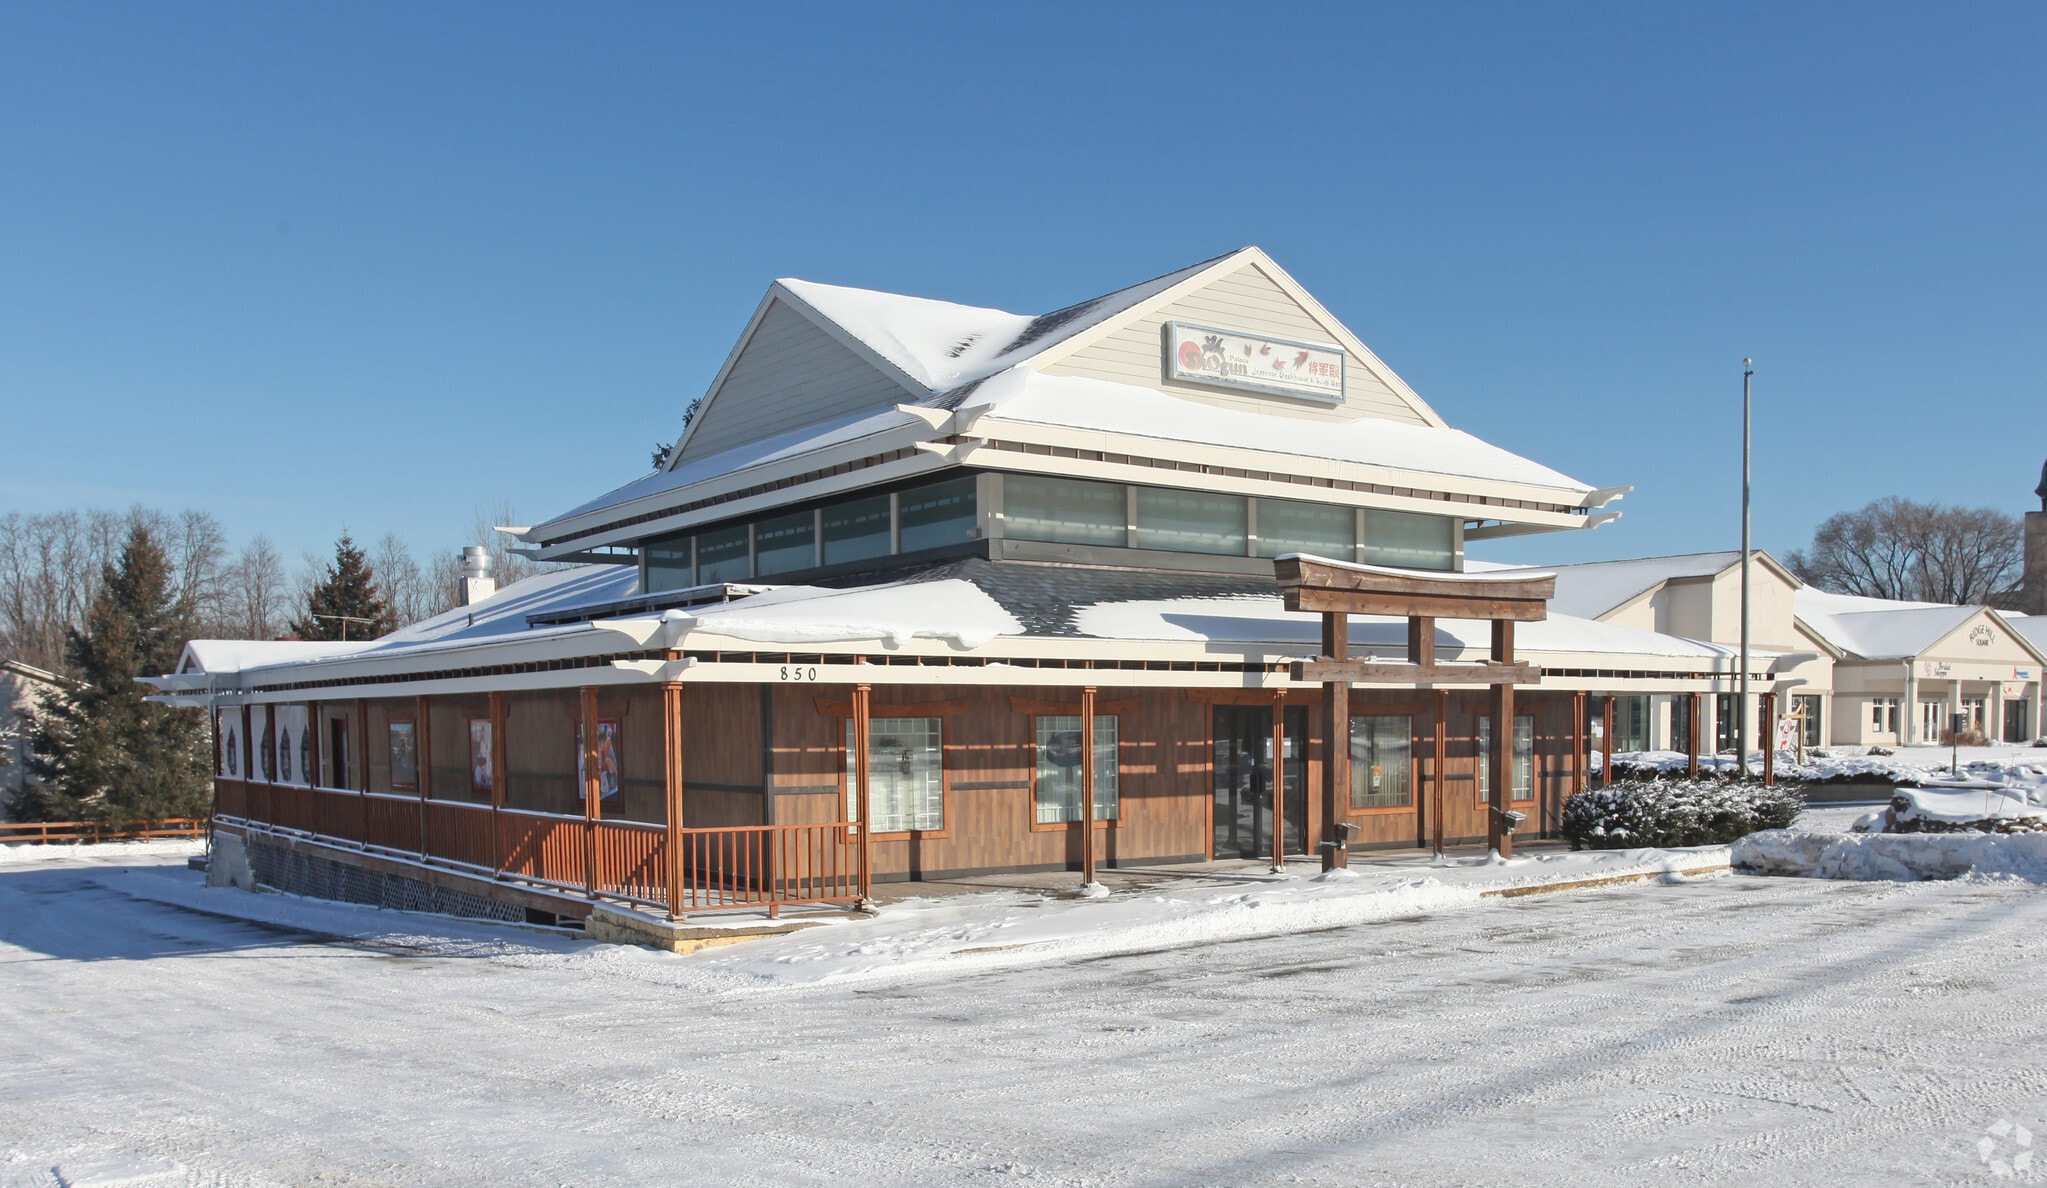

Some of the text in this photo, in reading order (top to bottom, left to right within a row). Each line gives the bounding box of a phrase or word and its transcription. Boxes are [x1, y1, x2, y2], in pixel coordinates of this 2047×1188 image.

[1229, 354, 1249, 364] Palace
[1251, 366, 1278, 378] Japanese
[1969, 624, 1996, 645] RIDGE HILL
[780, 666, 816, 681] 850
